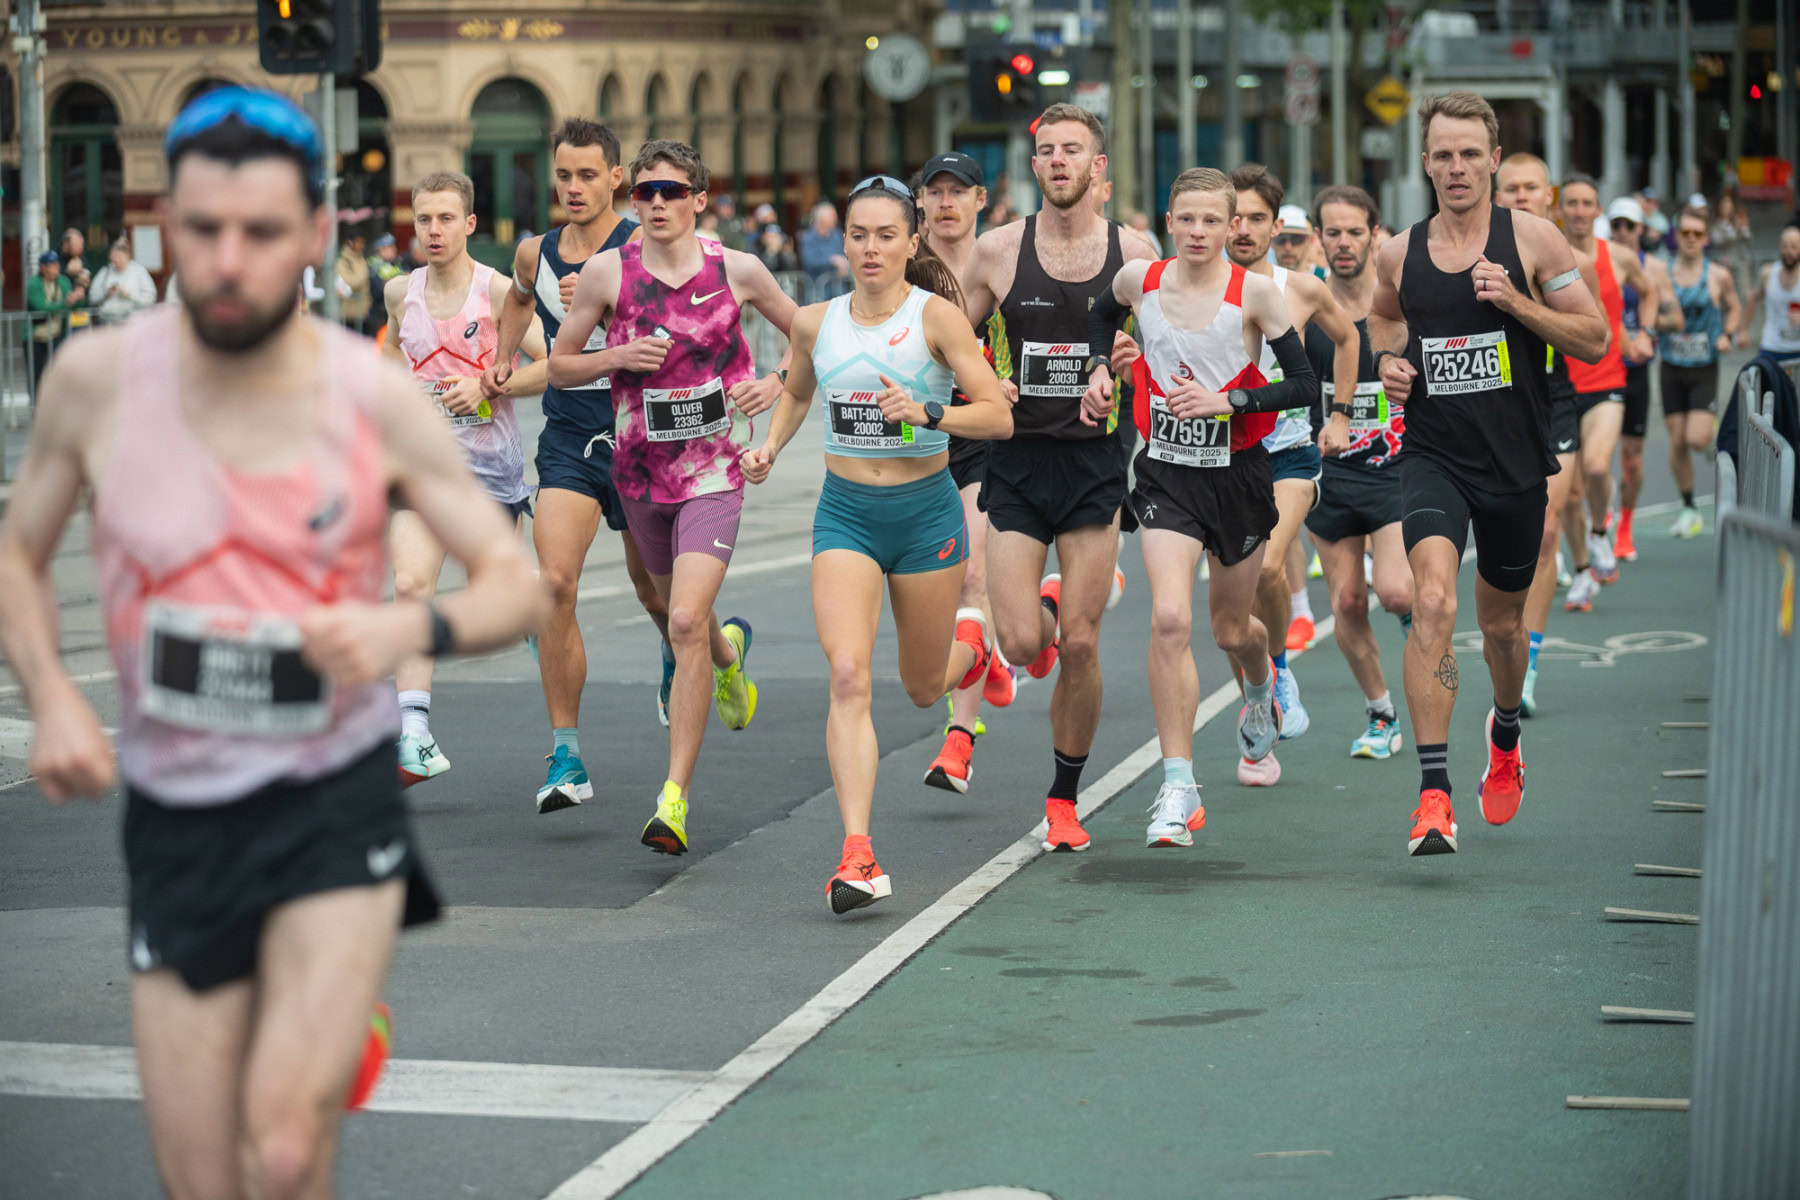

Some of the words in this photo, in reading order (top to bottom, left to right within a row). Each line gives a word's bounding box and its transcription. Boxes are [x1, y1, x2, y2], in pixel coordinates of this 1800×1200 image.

[62, 26, 180, 48] YOUNG
[1046, 359, 1082, 372] ARNOLD
[1431, 348, 1501, 382] 25246
[600, 379, 611, 387] 20
[1048, 372, 1078, 385] 20030
[1434, 381, 1480, 393] MELBOURNE
[1482, 377, 1502, 389] 2025
[1029, 386, 1074, 395] MELBOURNE
[1076, 386, 1088, 395] 20
[671, 401, 704, 416] OLIVER
[841, 406, 888, 421] BATT-DOY
[674, 413, 704, 429] 23362
[853, 421, 884, 436] 20002
[656, 427, 702, 440] MELBOURNE
[704, 420, 722, 434] 2025
[1157, 412, 1220, 446] 27597
[837, 436, 882, 447] MELBOURNE
[1156, 441, 1198, 457] MELBOURNE
[1200, 448, 1221, 457] 2025
